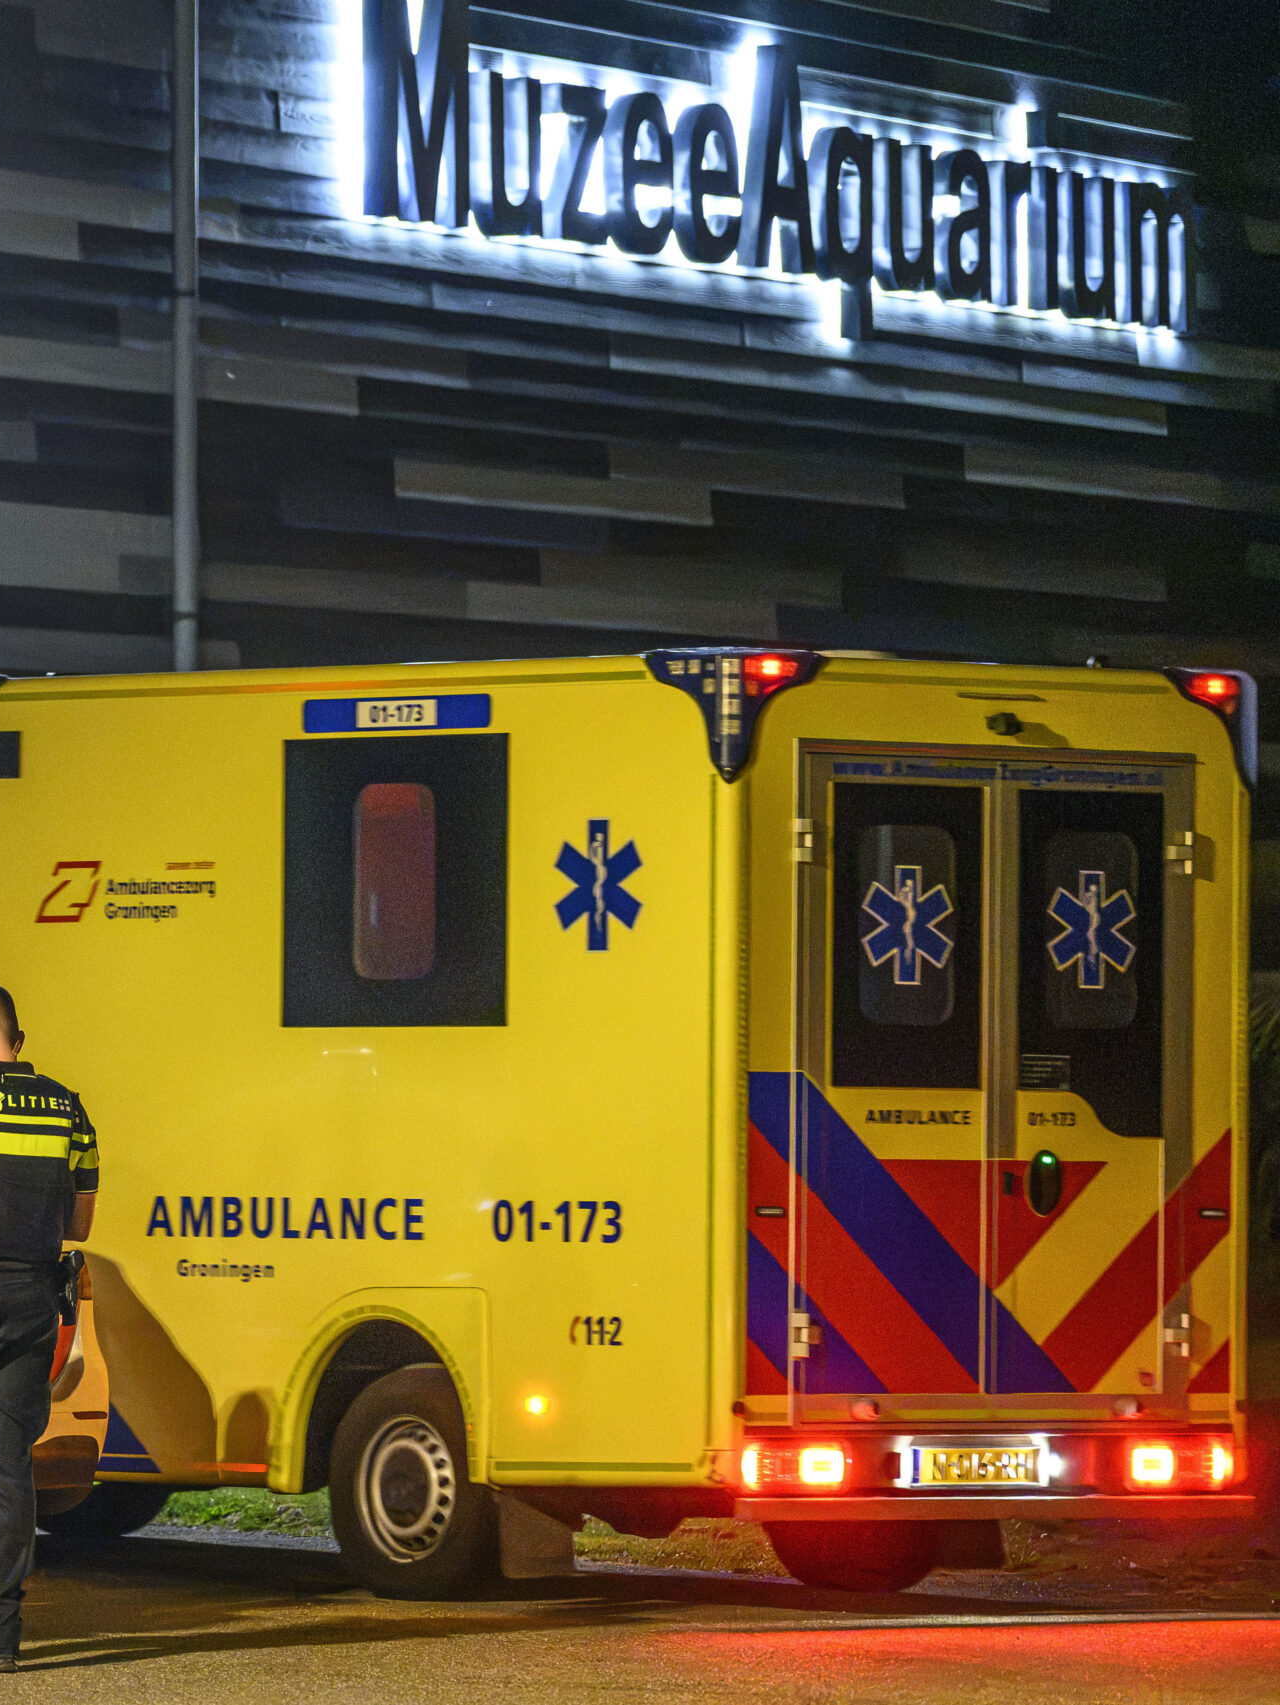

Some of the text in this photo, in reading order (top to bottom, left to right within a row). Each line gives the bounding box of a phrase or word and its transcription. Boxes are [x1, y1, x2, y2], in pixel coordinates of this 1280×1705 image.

[362, 0, 1188, 340] MuzeeAquarium
[370, 704, 424, 723] 01-173
[105, 878, 217, 898] Ambulancezorg
[104, 901, 179, 923] Groningen
[865, 1109, 972, 1125] AMBULANCE
[1027, 1111, 1076, 1127] 01-173
[146, 1195, 624, 1244] AMBULANCE 01-173
[176, 1258, 275, 1283] Groningen
